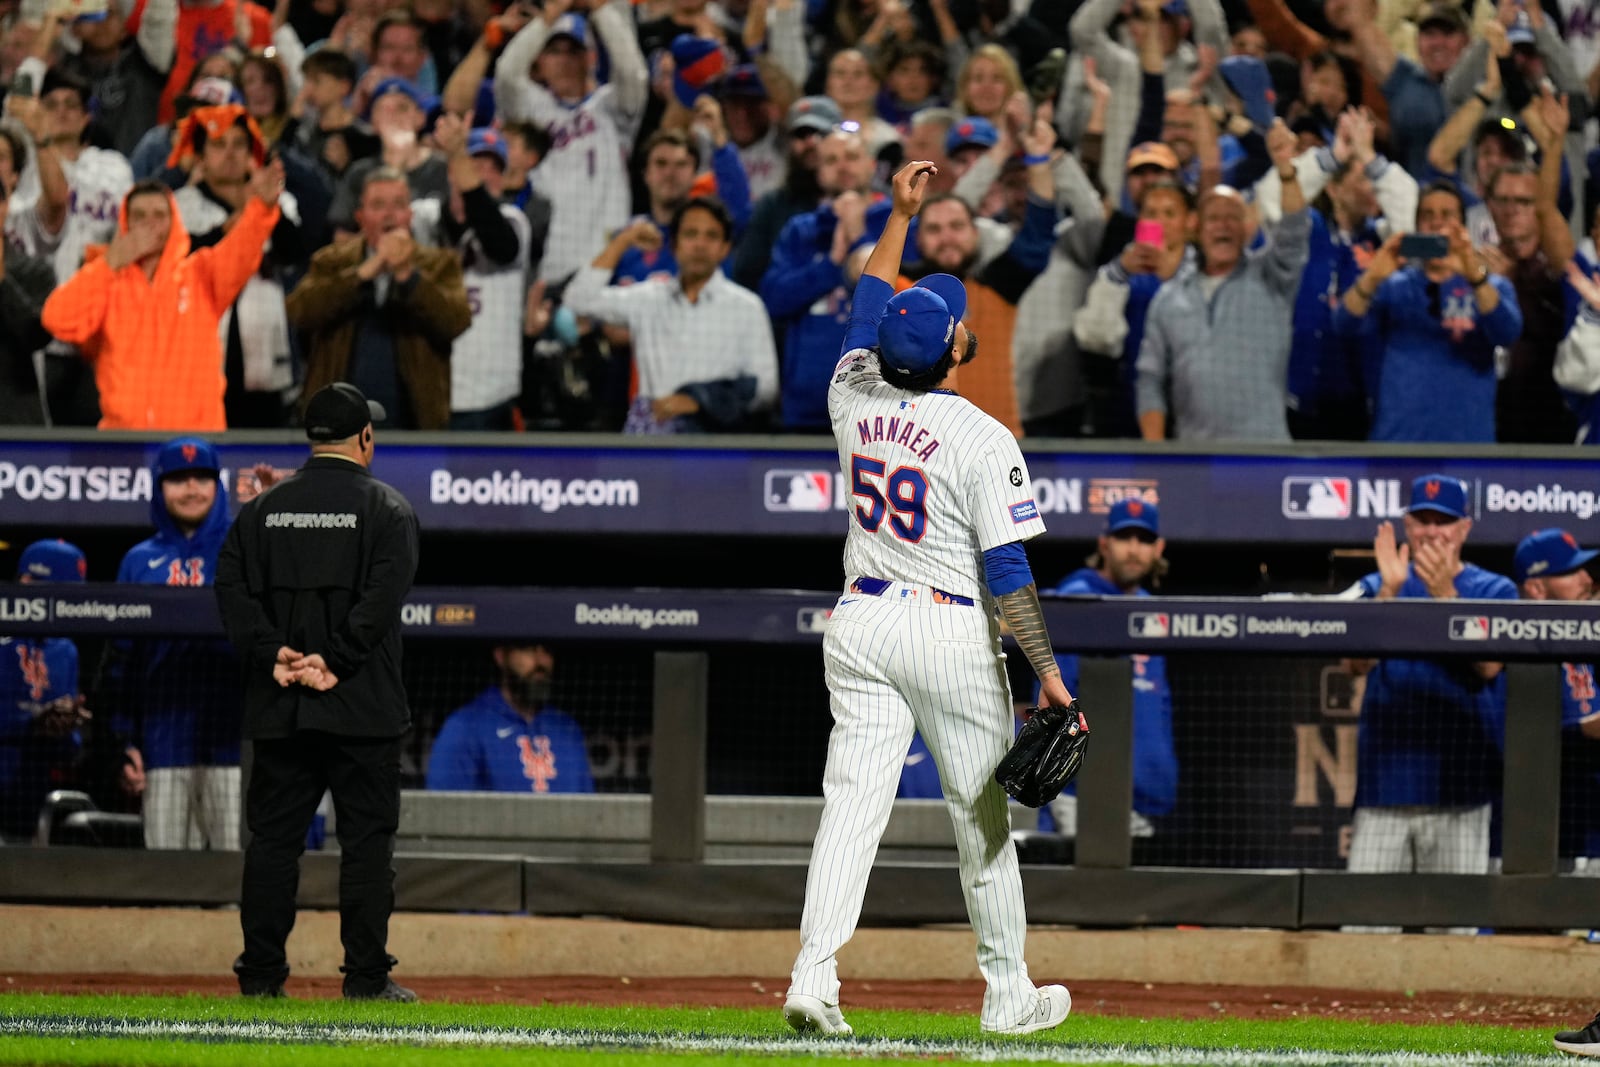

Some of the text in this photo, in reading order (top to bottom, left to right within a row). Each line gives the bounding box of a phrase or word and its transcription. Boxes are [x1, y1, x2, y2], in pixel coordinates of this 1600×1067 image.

[857, 416, 940, 463] MANAEA
[0, 462, 229, 500] POSTSEA
[1010, 469, 1023, 486] 24
[430, 470, 639, 512] Booking.com
[852, 453, 930, 543] 59
[1487, 483, 1600, 520] Booking.
[265, 512, 357, 529] SUPERVISOR
[0, 598, 47, 622] LDS
[56, 600, 152, 621] Booking.com
[575, 603, 699, 629] Booking.com
[1172, 614, 1238, 637] NLDS
[1247, 617, 1347, 637] Booking.com
[1491, 617, 1600, 640] POSTSEAS
